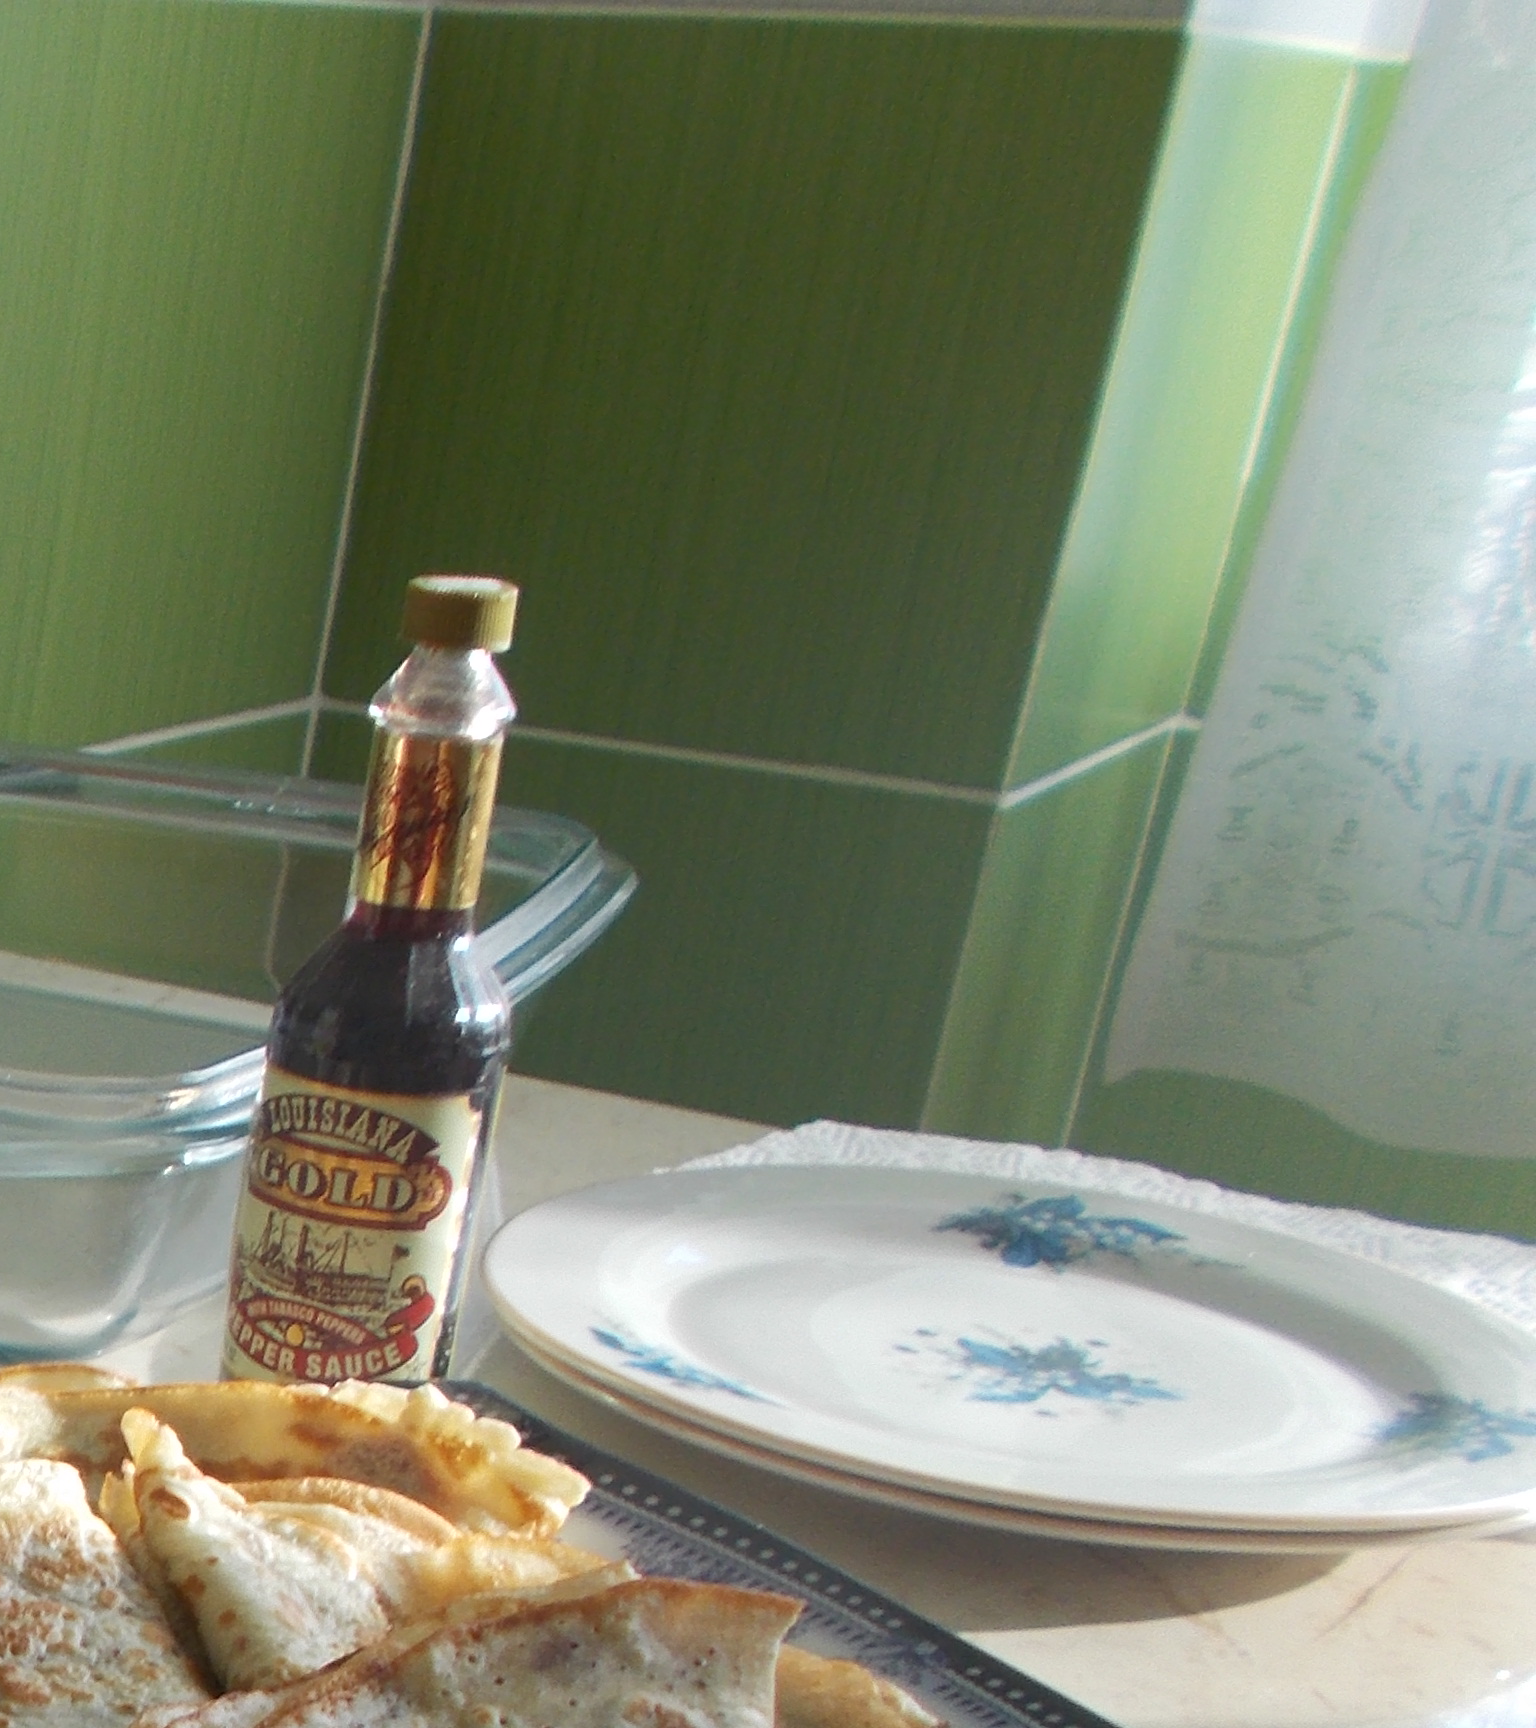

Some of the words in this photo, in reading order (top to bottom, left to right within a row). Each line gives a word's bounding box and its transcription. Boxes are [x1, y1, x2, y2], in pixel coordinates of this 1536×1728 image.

[269, 1096, 416, 1164] LOUISIANA
[258, 1147, 414, 1211] GOLD
[304, 1341, 401, 1378] SAUCE
